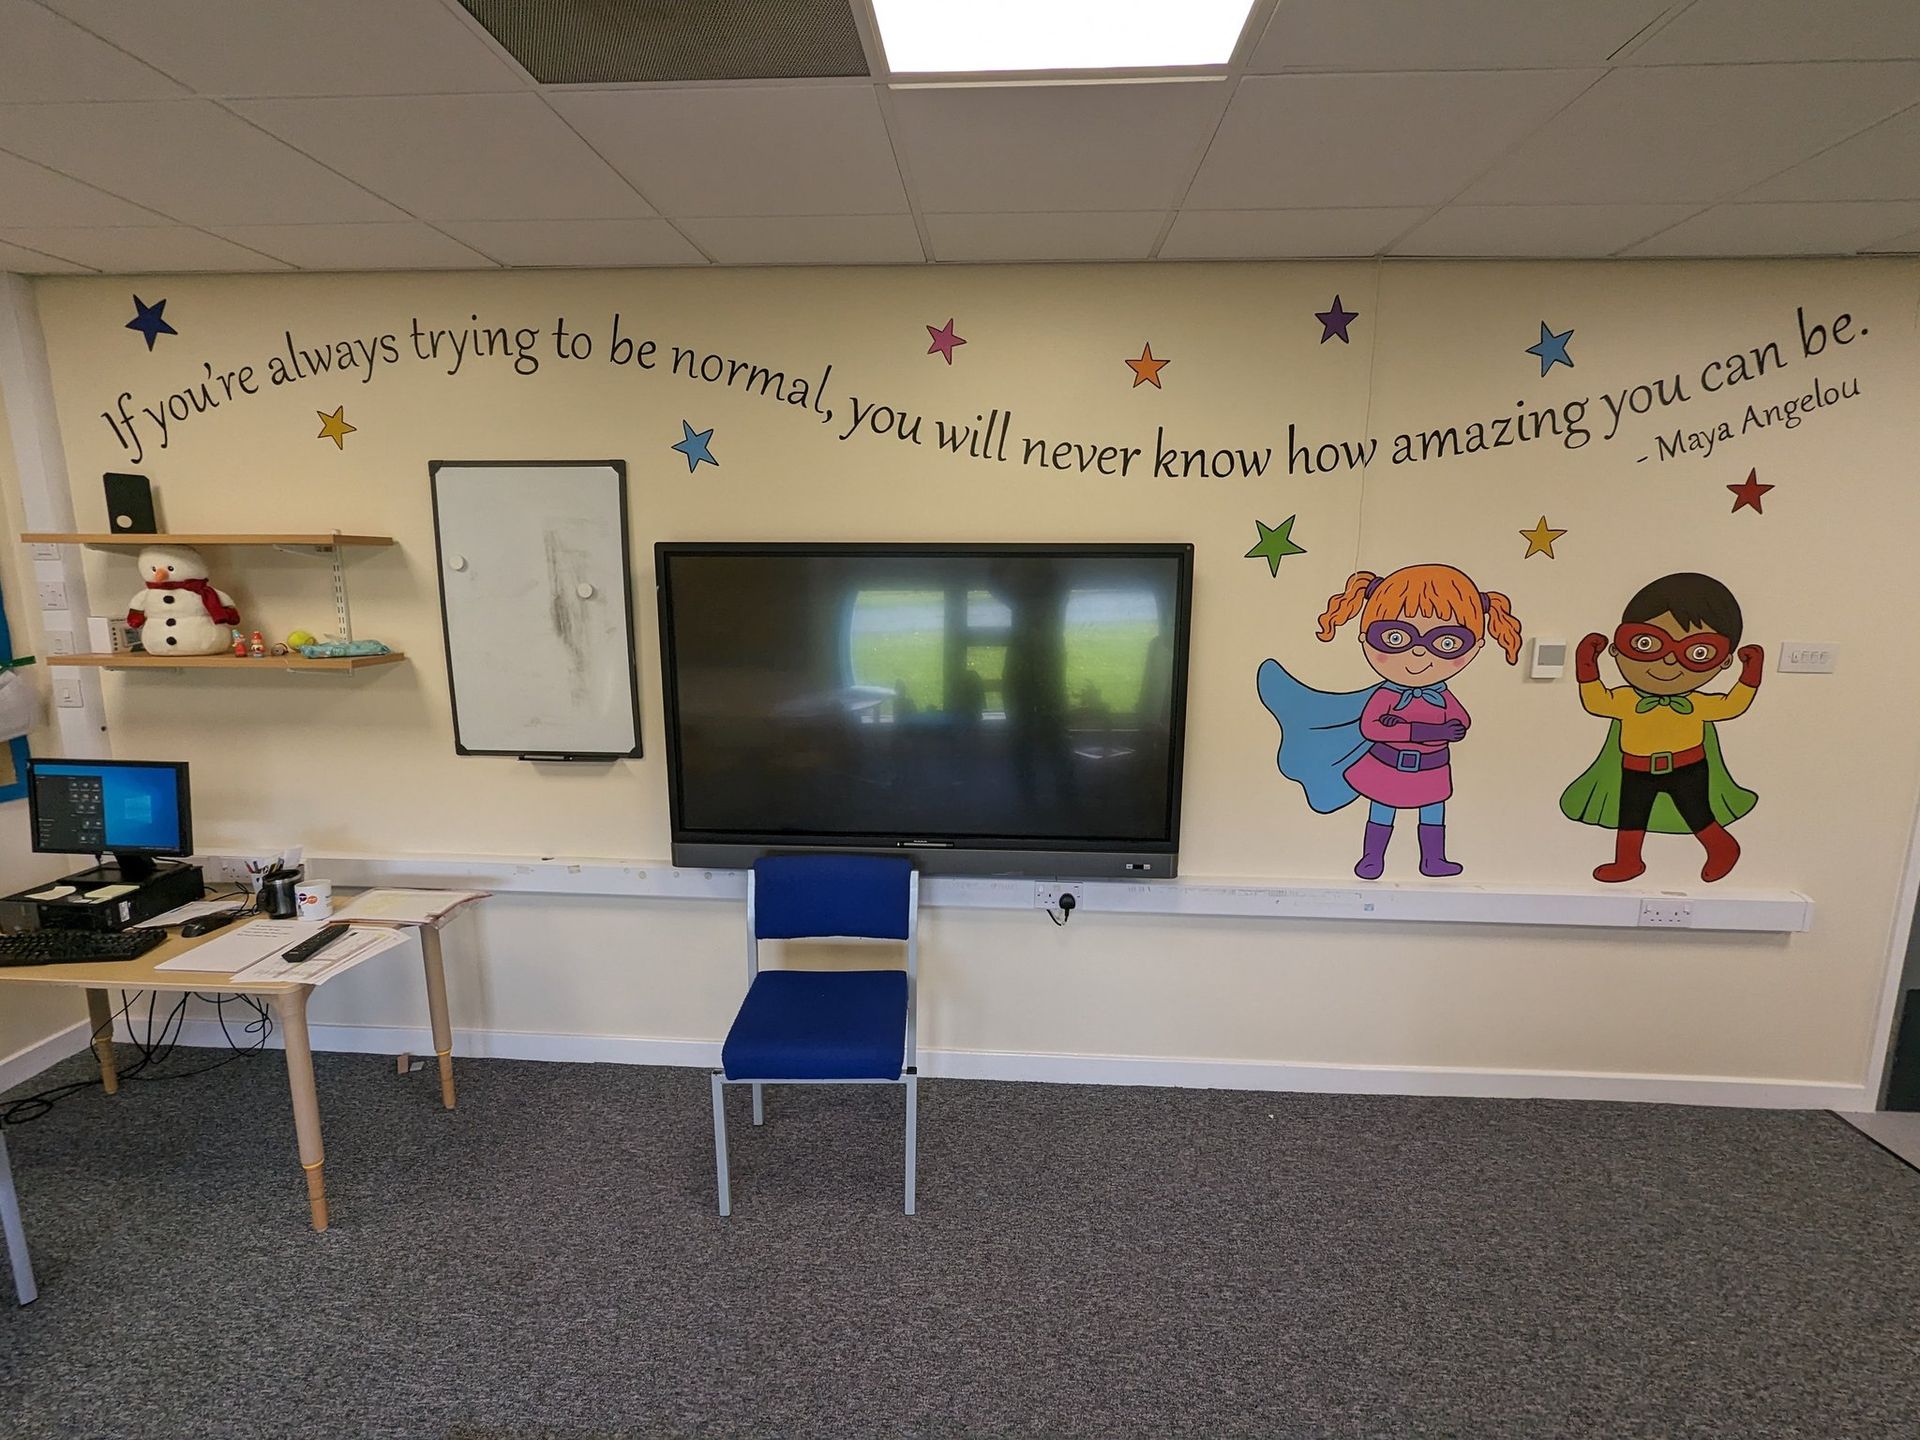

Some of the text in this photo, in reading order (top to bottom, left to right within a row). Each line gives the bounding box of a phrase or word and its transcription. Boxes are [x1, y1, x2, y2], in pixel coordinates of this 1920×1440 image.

[101, 306, 1868, 478] If you're always trying to be normal, you will never know how amazing you can be.
[1655, 429, 1734, 461] Maya
[1741, 377, 1861, 429] Angelou
